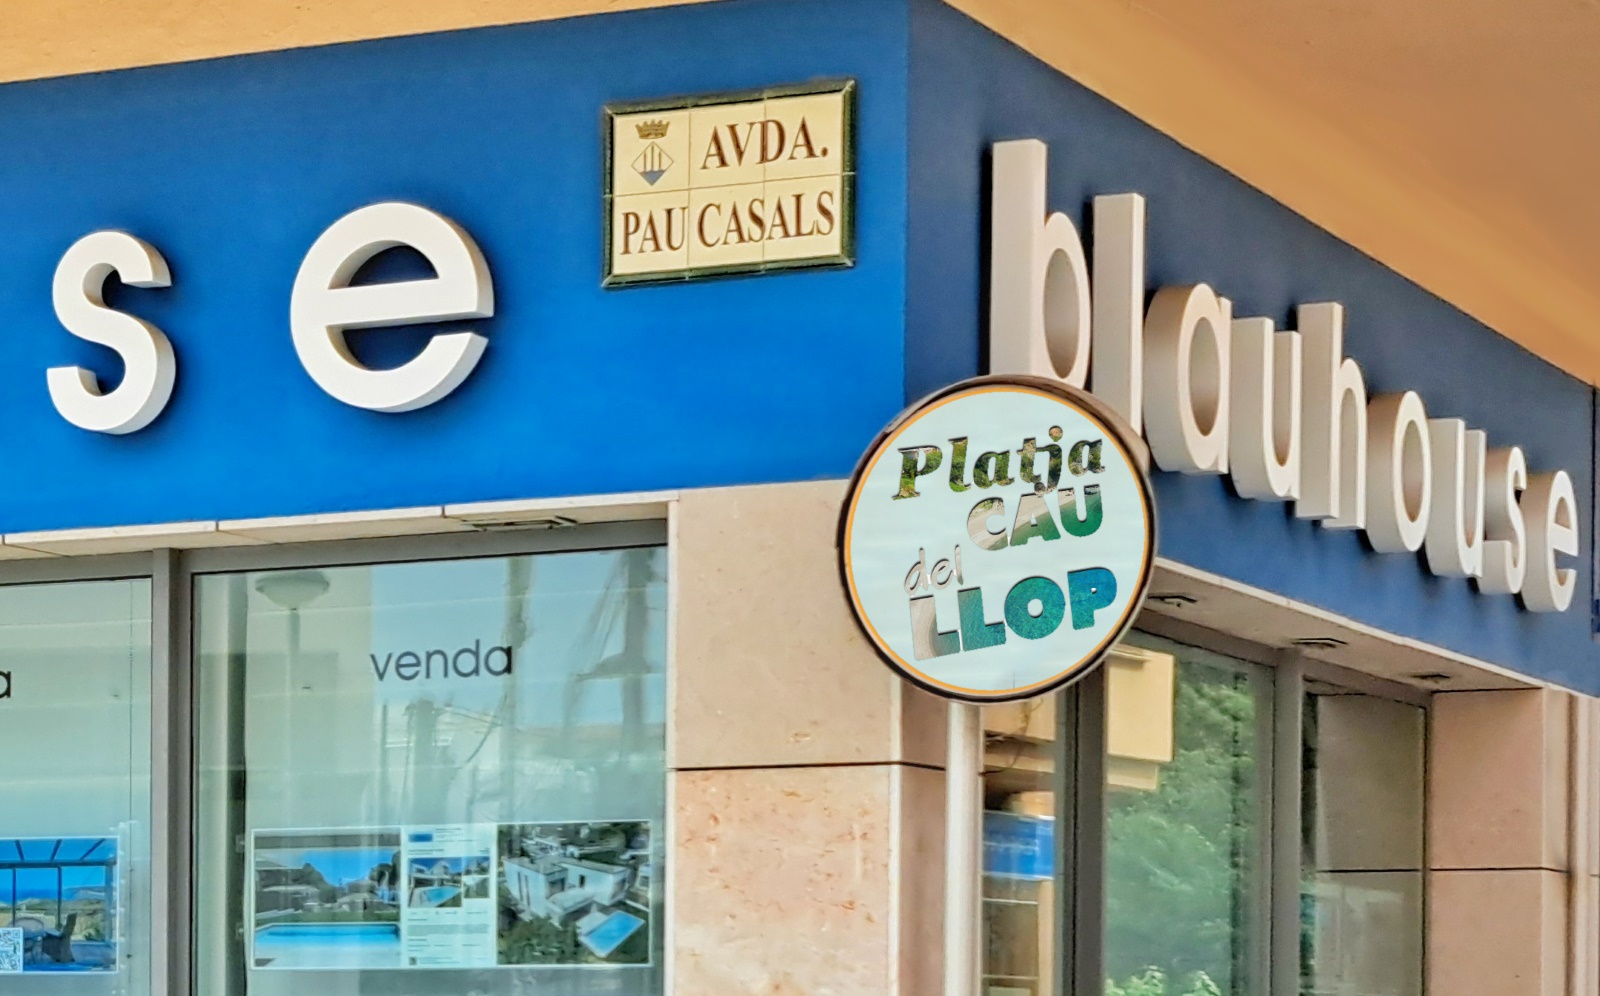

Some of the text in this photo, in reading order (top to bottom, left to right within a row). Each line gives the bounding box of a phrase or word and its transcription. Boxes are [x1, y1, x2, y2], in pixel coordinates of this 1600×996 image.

[700, 115, 829, 170] AVDA.
[620, 190, 835, 255] PAU CASALS
[989, 138, 1579, 612] blauhouse
[891, 425, 1106, 500] Platja
[966, 484, 1104, 551] CAU
[903, 544, 964, 596] del
[909, 566, 1118, 661] LLOP
[370, 639, 514, 683] venda
